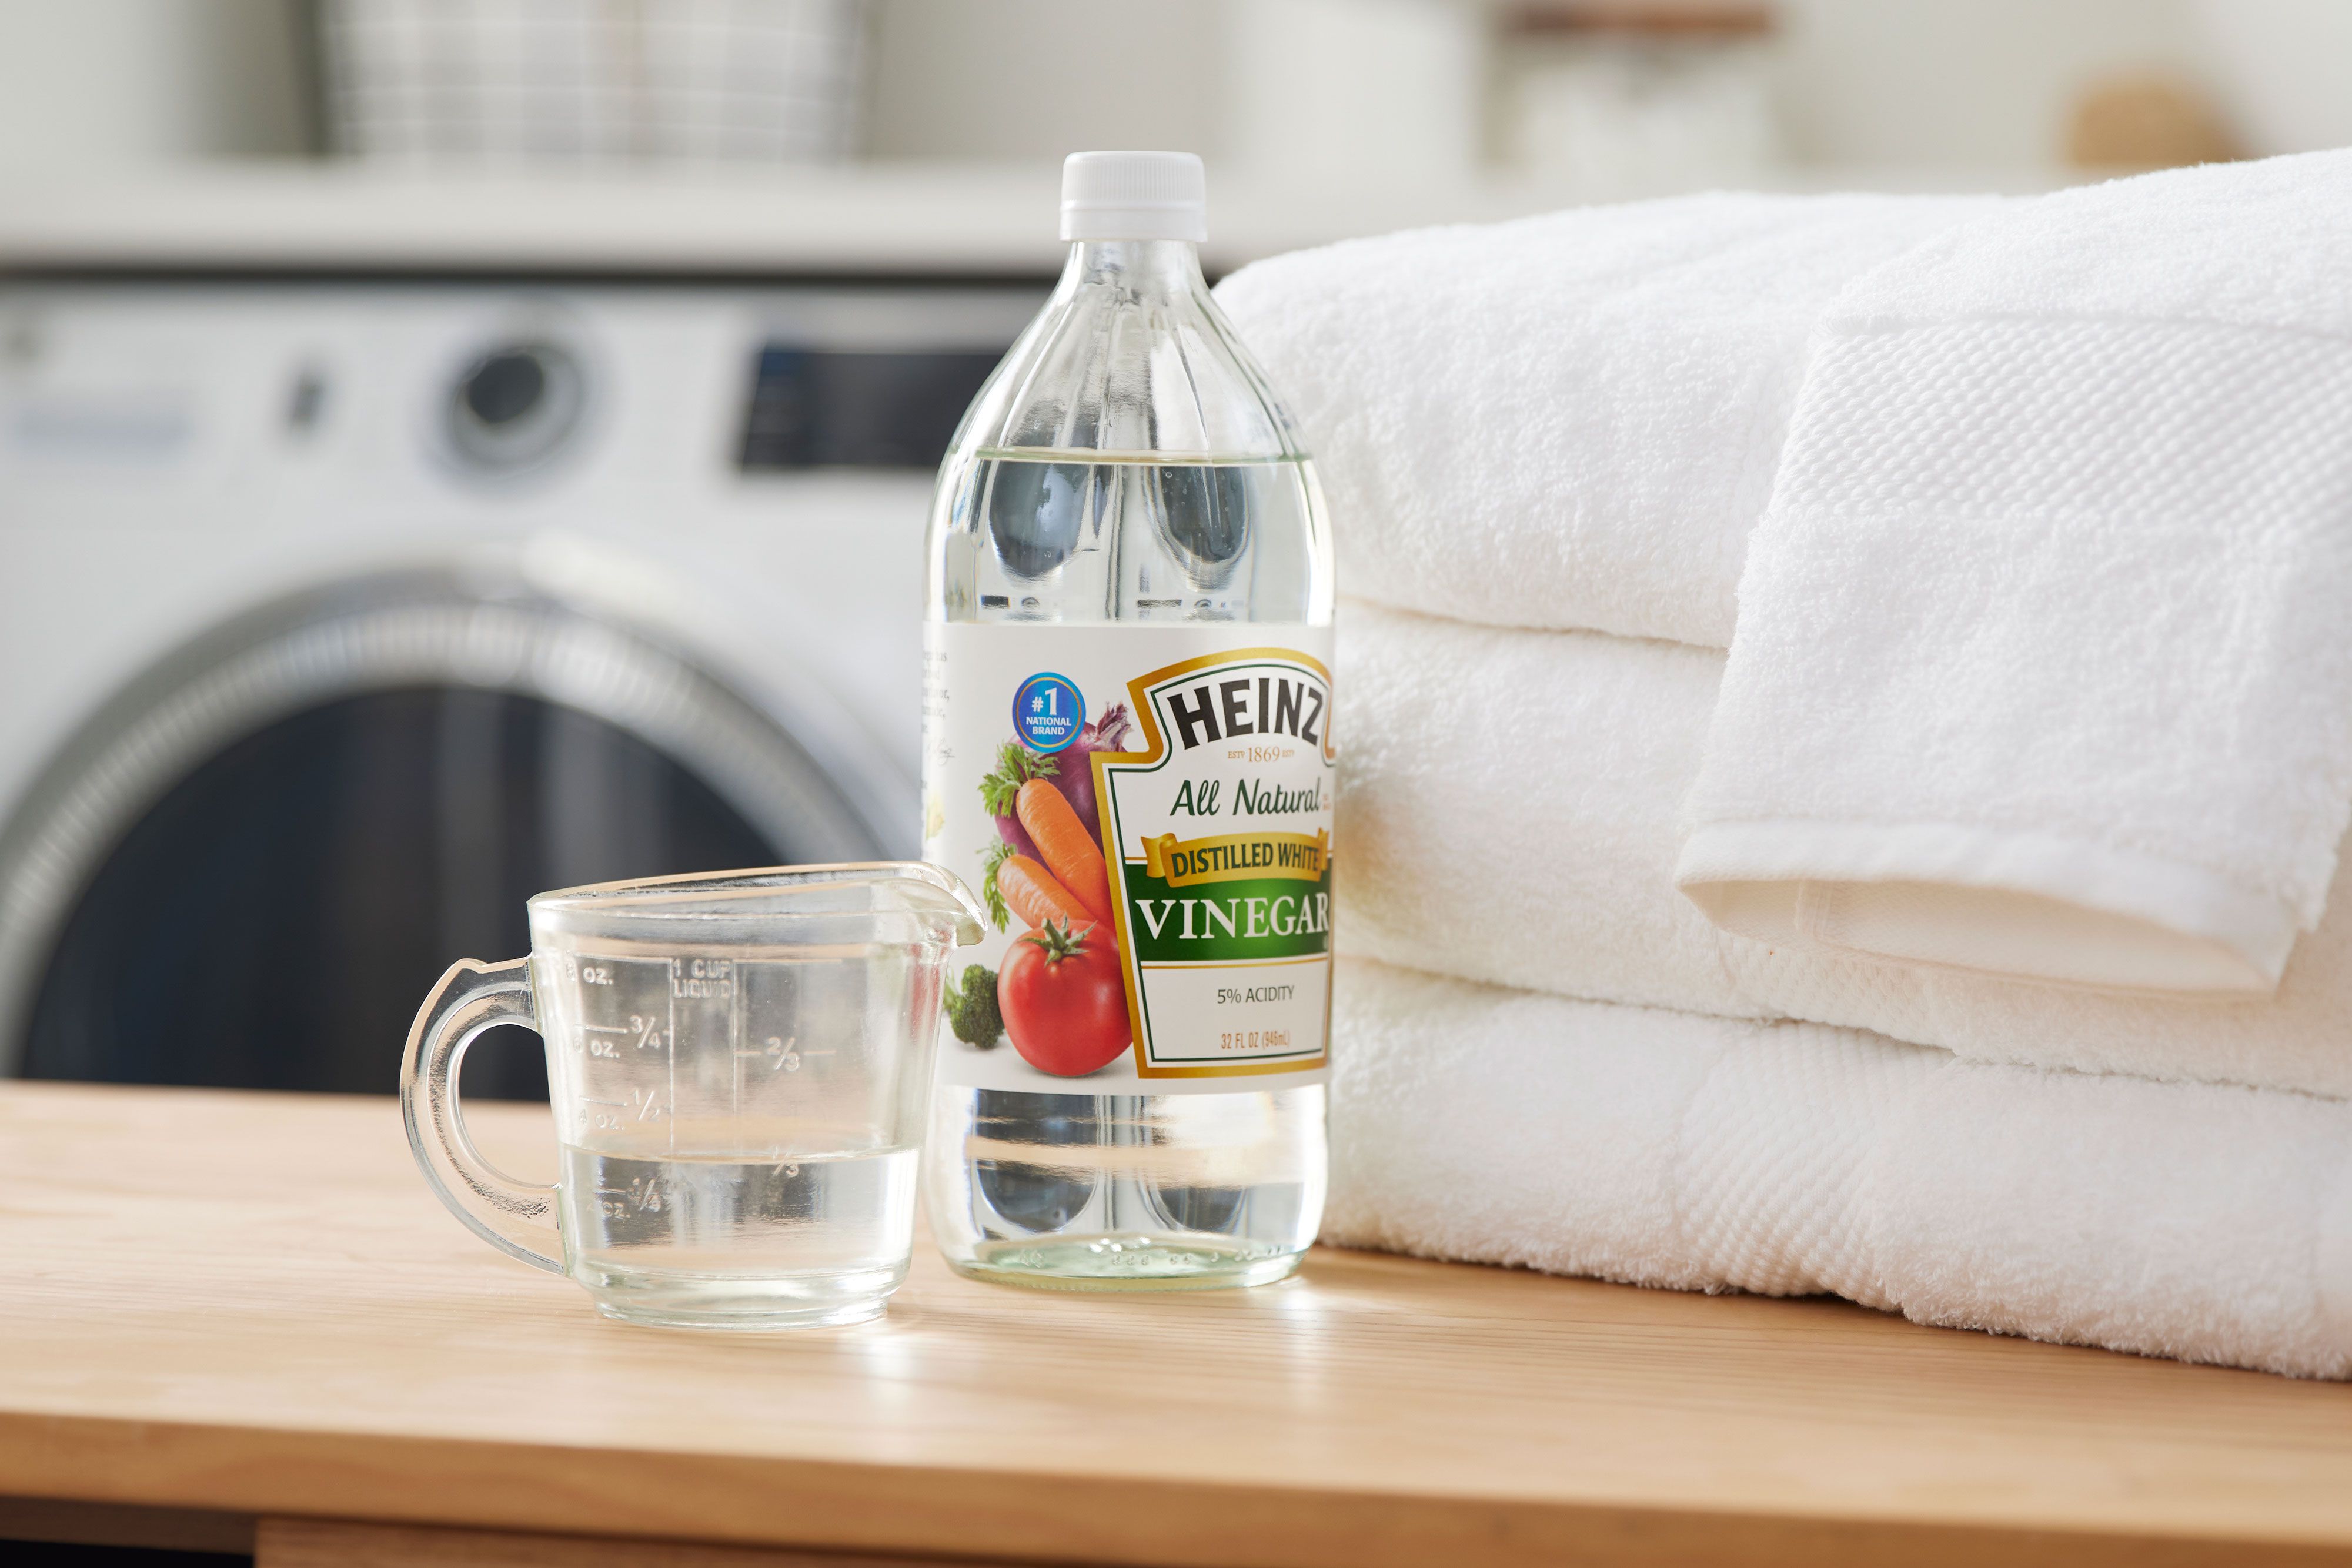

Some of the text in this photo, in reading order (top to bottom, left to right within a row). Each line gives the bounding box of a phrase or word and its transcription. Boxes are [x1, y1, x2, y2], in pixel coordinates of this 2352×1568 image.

[1031, 687, 1057, 716] #1
[1167, 678, 1322, 750] HEINZ
[1025, 717, 1071, 726] NATIONAL
[1033, 726, 1065, 735] BRAND
[1248, 747, 1280, 762] 1869
[1170, 780, 1220, 815] All
[1232, 776, 1320, 815] Natural
[1171, 842, 1319, 878] DISTILLED WHITE
[1135, 892, 1329, 940] VINEGAR
[691, 959, 730, 978] CUP
[673, 978, 731, 998] LIQUID
[1217, 985, 1294, 1004] 5% ACIDITY
[630, 1015, 661, 1049] 3/4
[1221, 1034, 1232, 1049] 32
[1235, 1033, 1245, 1048] FL
[1248, 1032, 1259, 1048] OZ
[766, 1037, 800, 1071] 2/3
[633, 1090, 660, 1122] 1/2
